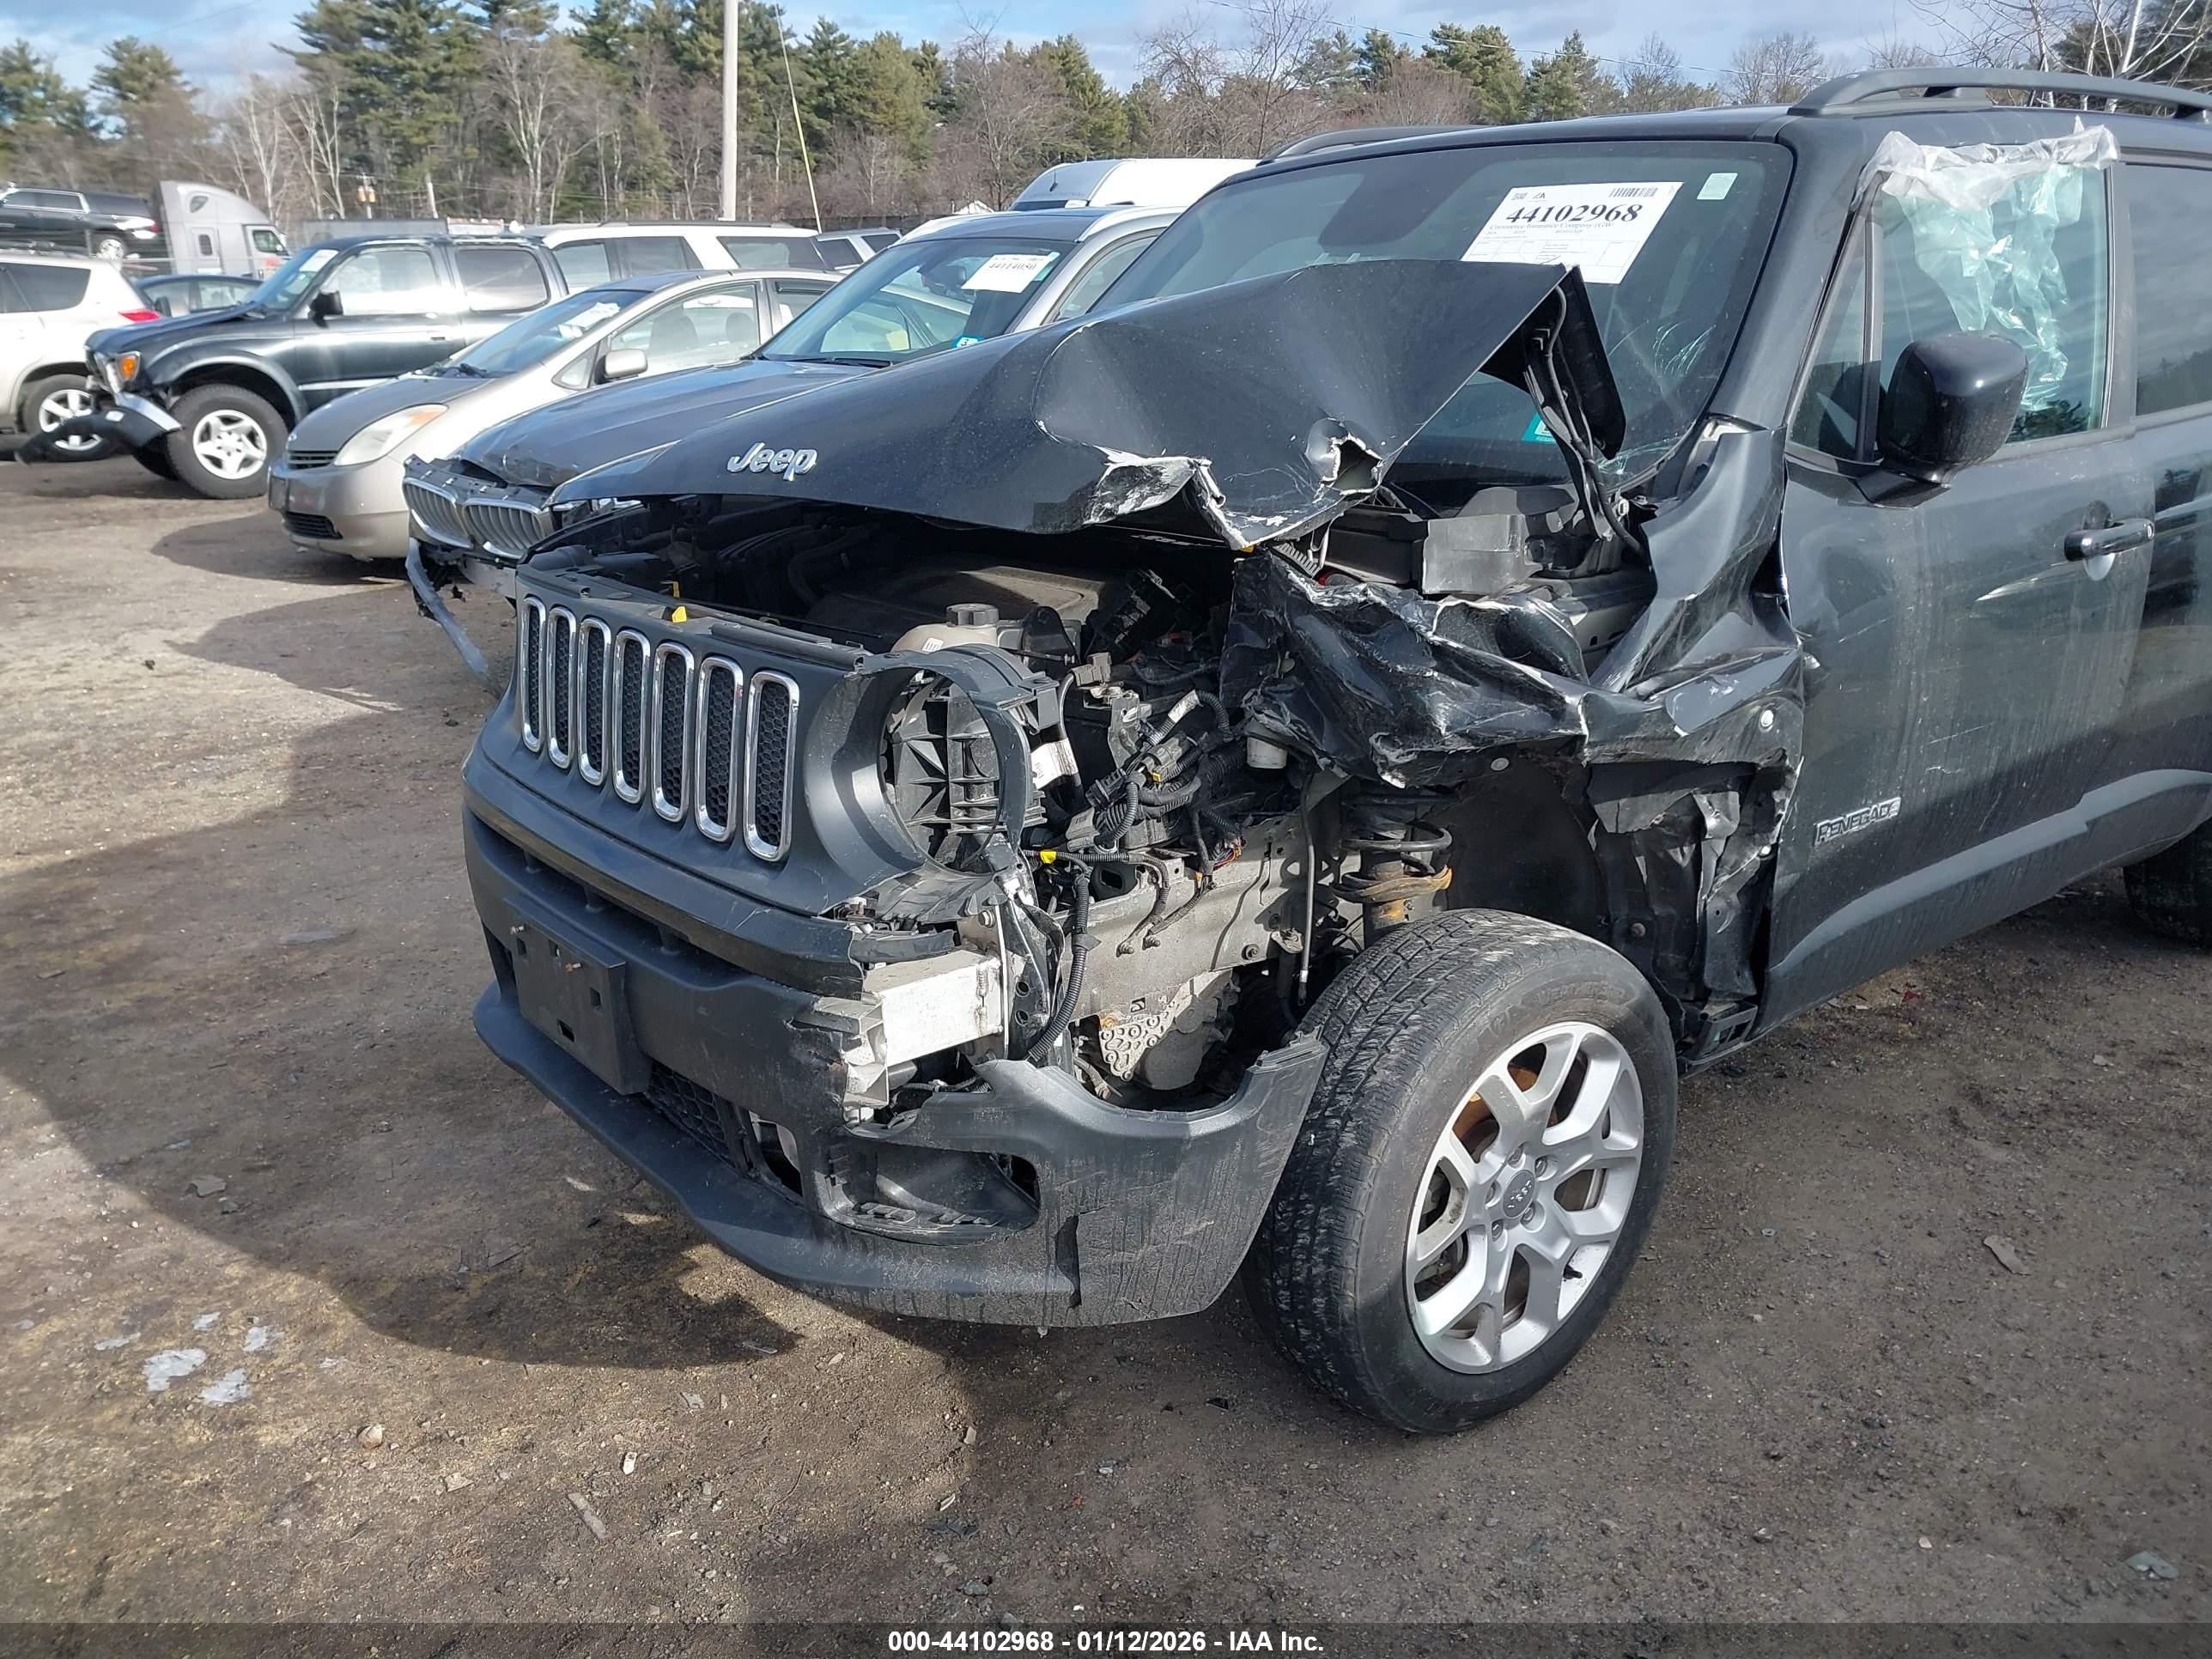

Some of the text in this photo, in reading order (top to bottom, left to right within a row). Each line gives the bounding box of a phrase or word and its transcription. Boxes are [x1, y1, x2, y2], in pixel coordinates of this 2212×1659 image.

[1505, 204, 1643, 223] 44102968
[726, 442, 817, 481] Jeep
[1814, 797, 1901, 847] RENEGADE
